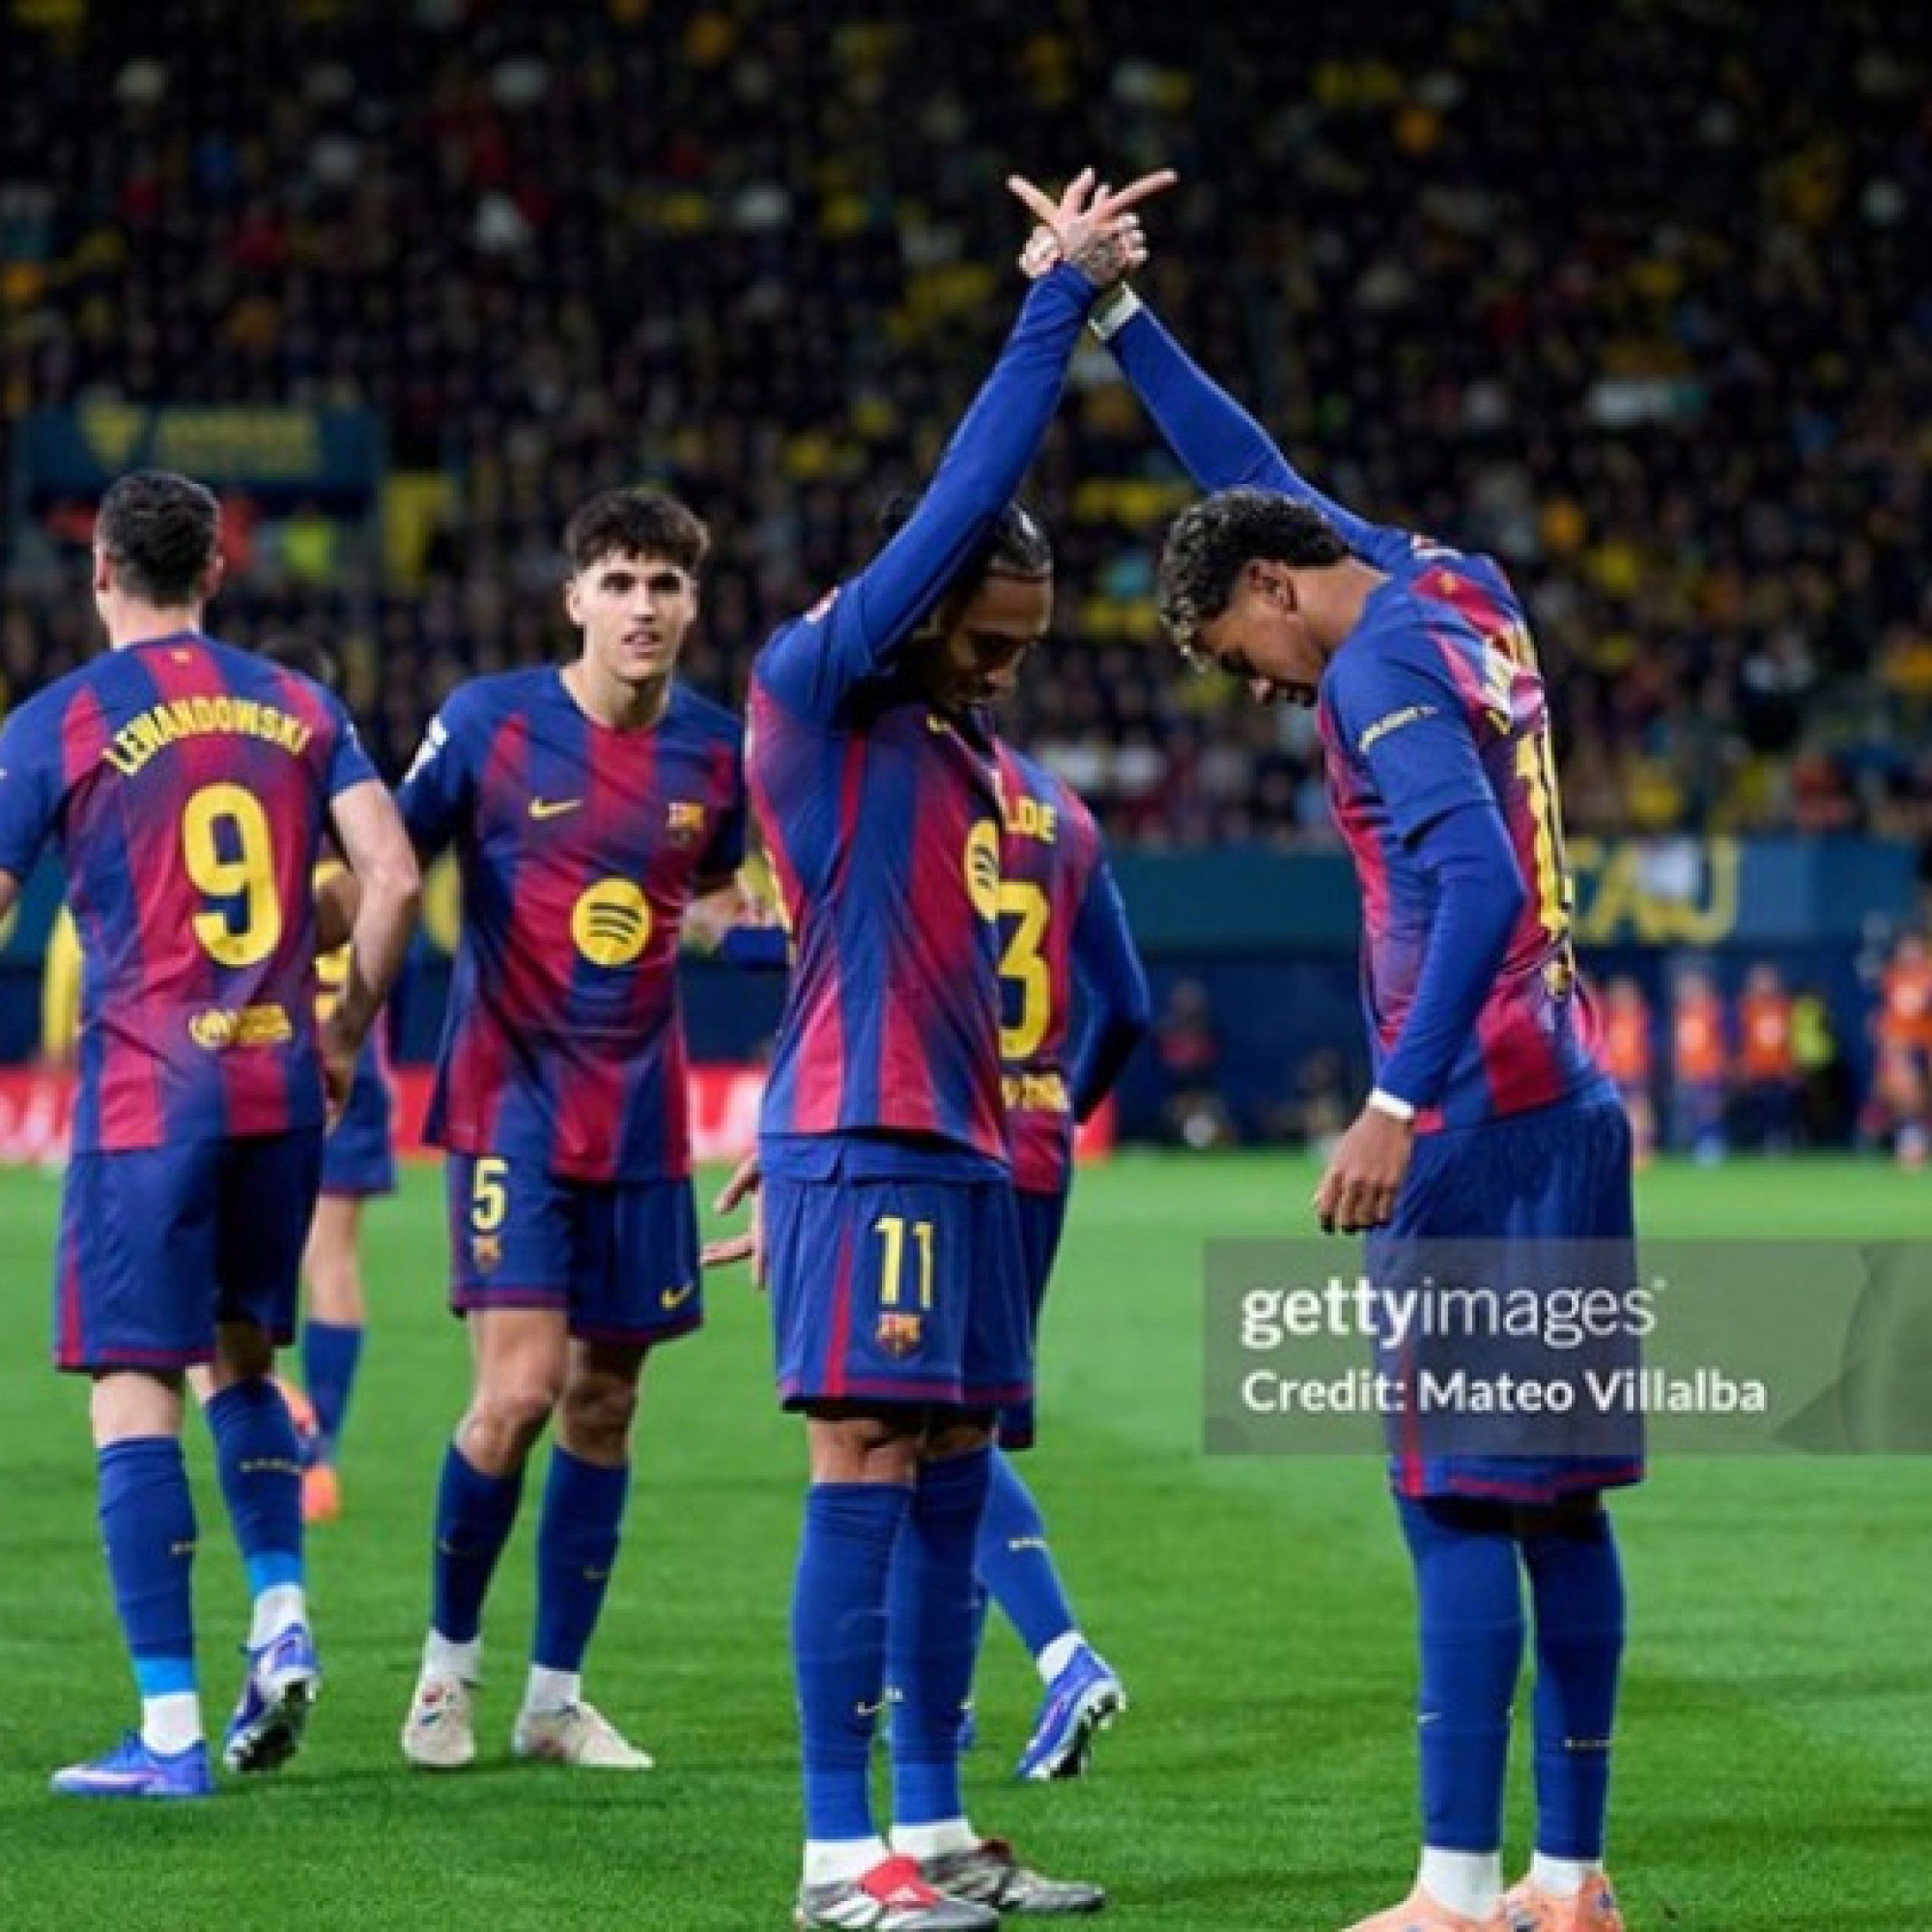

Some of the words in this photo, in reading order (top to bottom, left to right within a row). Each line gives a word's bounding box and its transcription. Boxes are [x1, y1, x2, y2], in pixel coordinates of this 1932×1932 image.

[999, 795, 1058, 845] LDE
[183, 781, 282, 967] 9
[997, 880, 1051, 1060] 3
[470, 1156, 509, 1231] 5
[873, 1214, 934, 1311] 11
